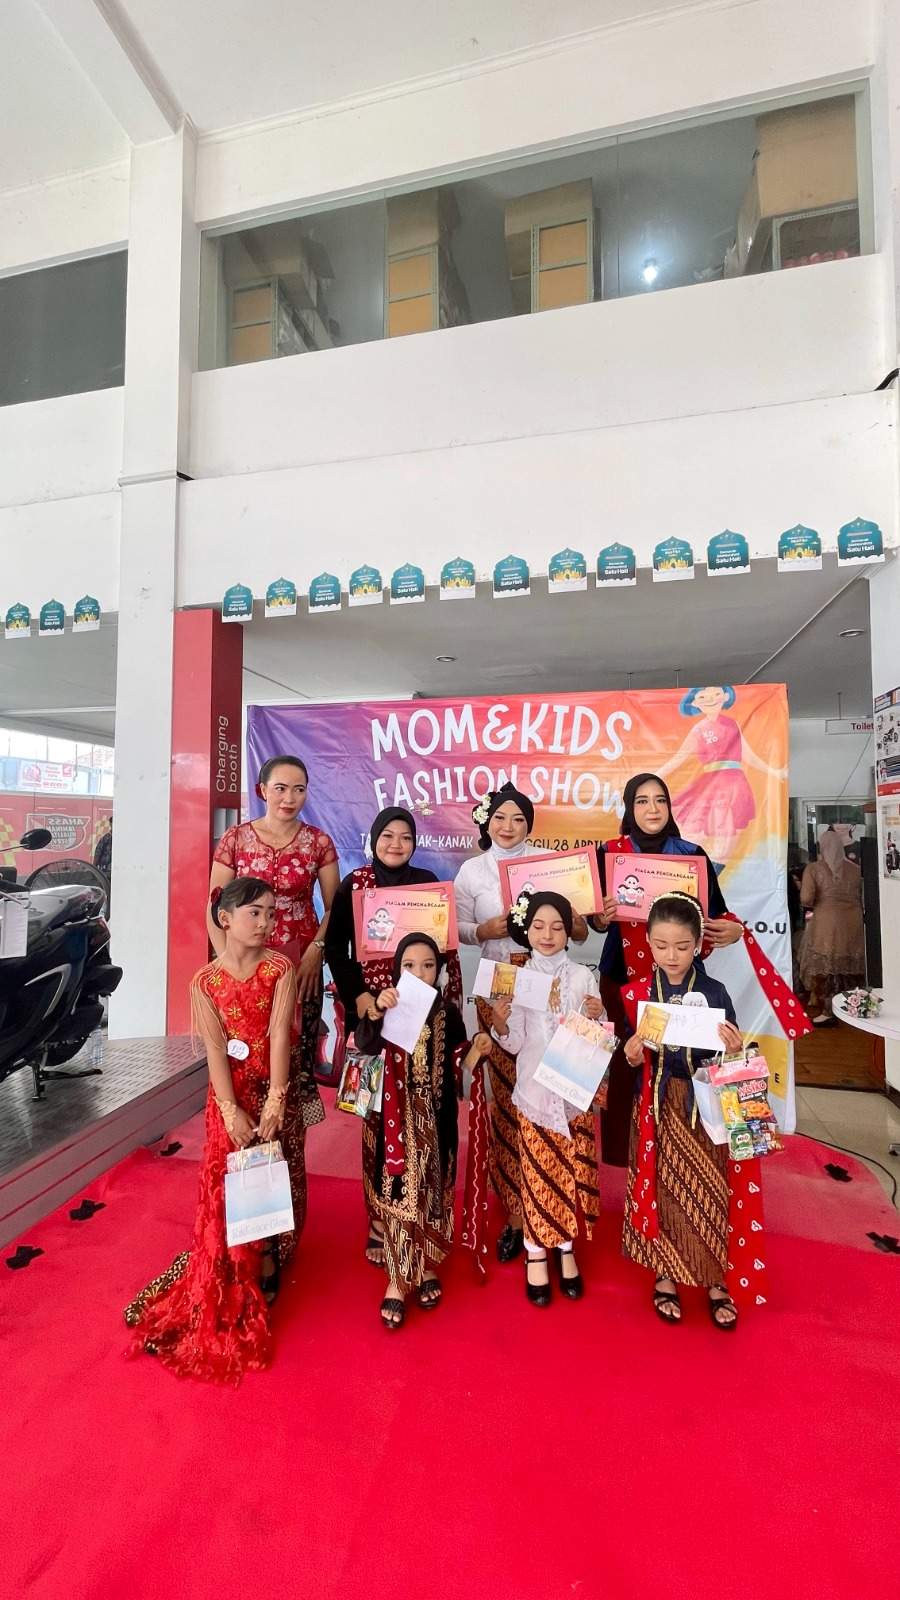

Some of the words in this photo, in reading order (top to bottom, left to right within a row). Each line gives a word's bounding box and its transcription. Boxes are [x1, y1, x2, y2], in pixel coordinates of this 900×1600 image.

[371, 702, 632, 761] MOM&KIDS
[851, 722, 874, 730] Toilet
[216, 716, 229, 792] Charging
[228, 744, 238, 793] booth
[373, 765, 518, 811] FASHION
